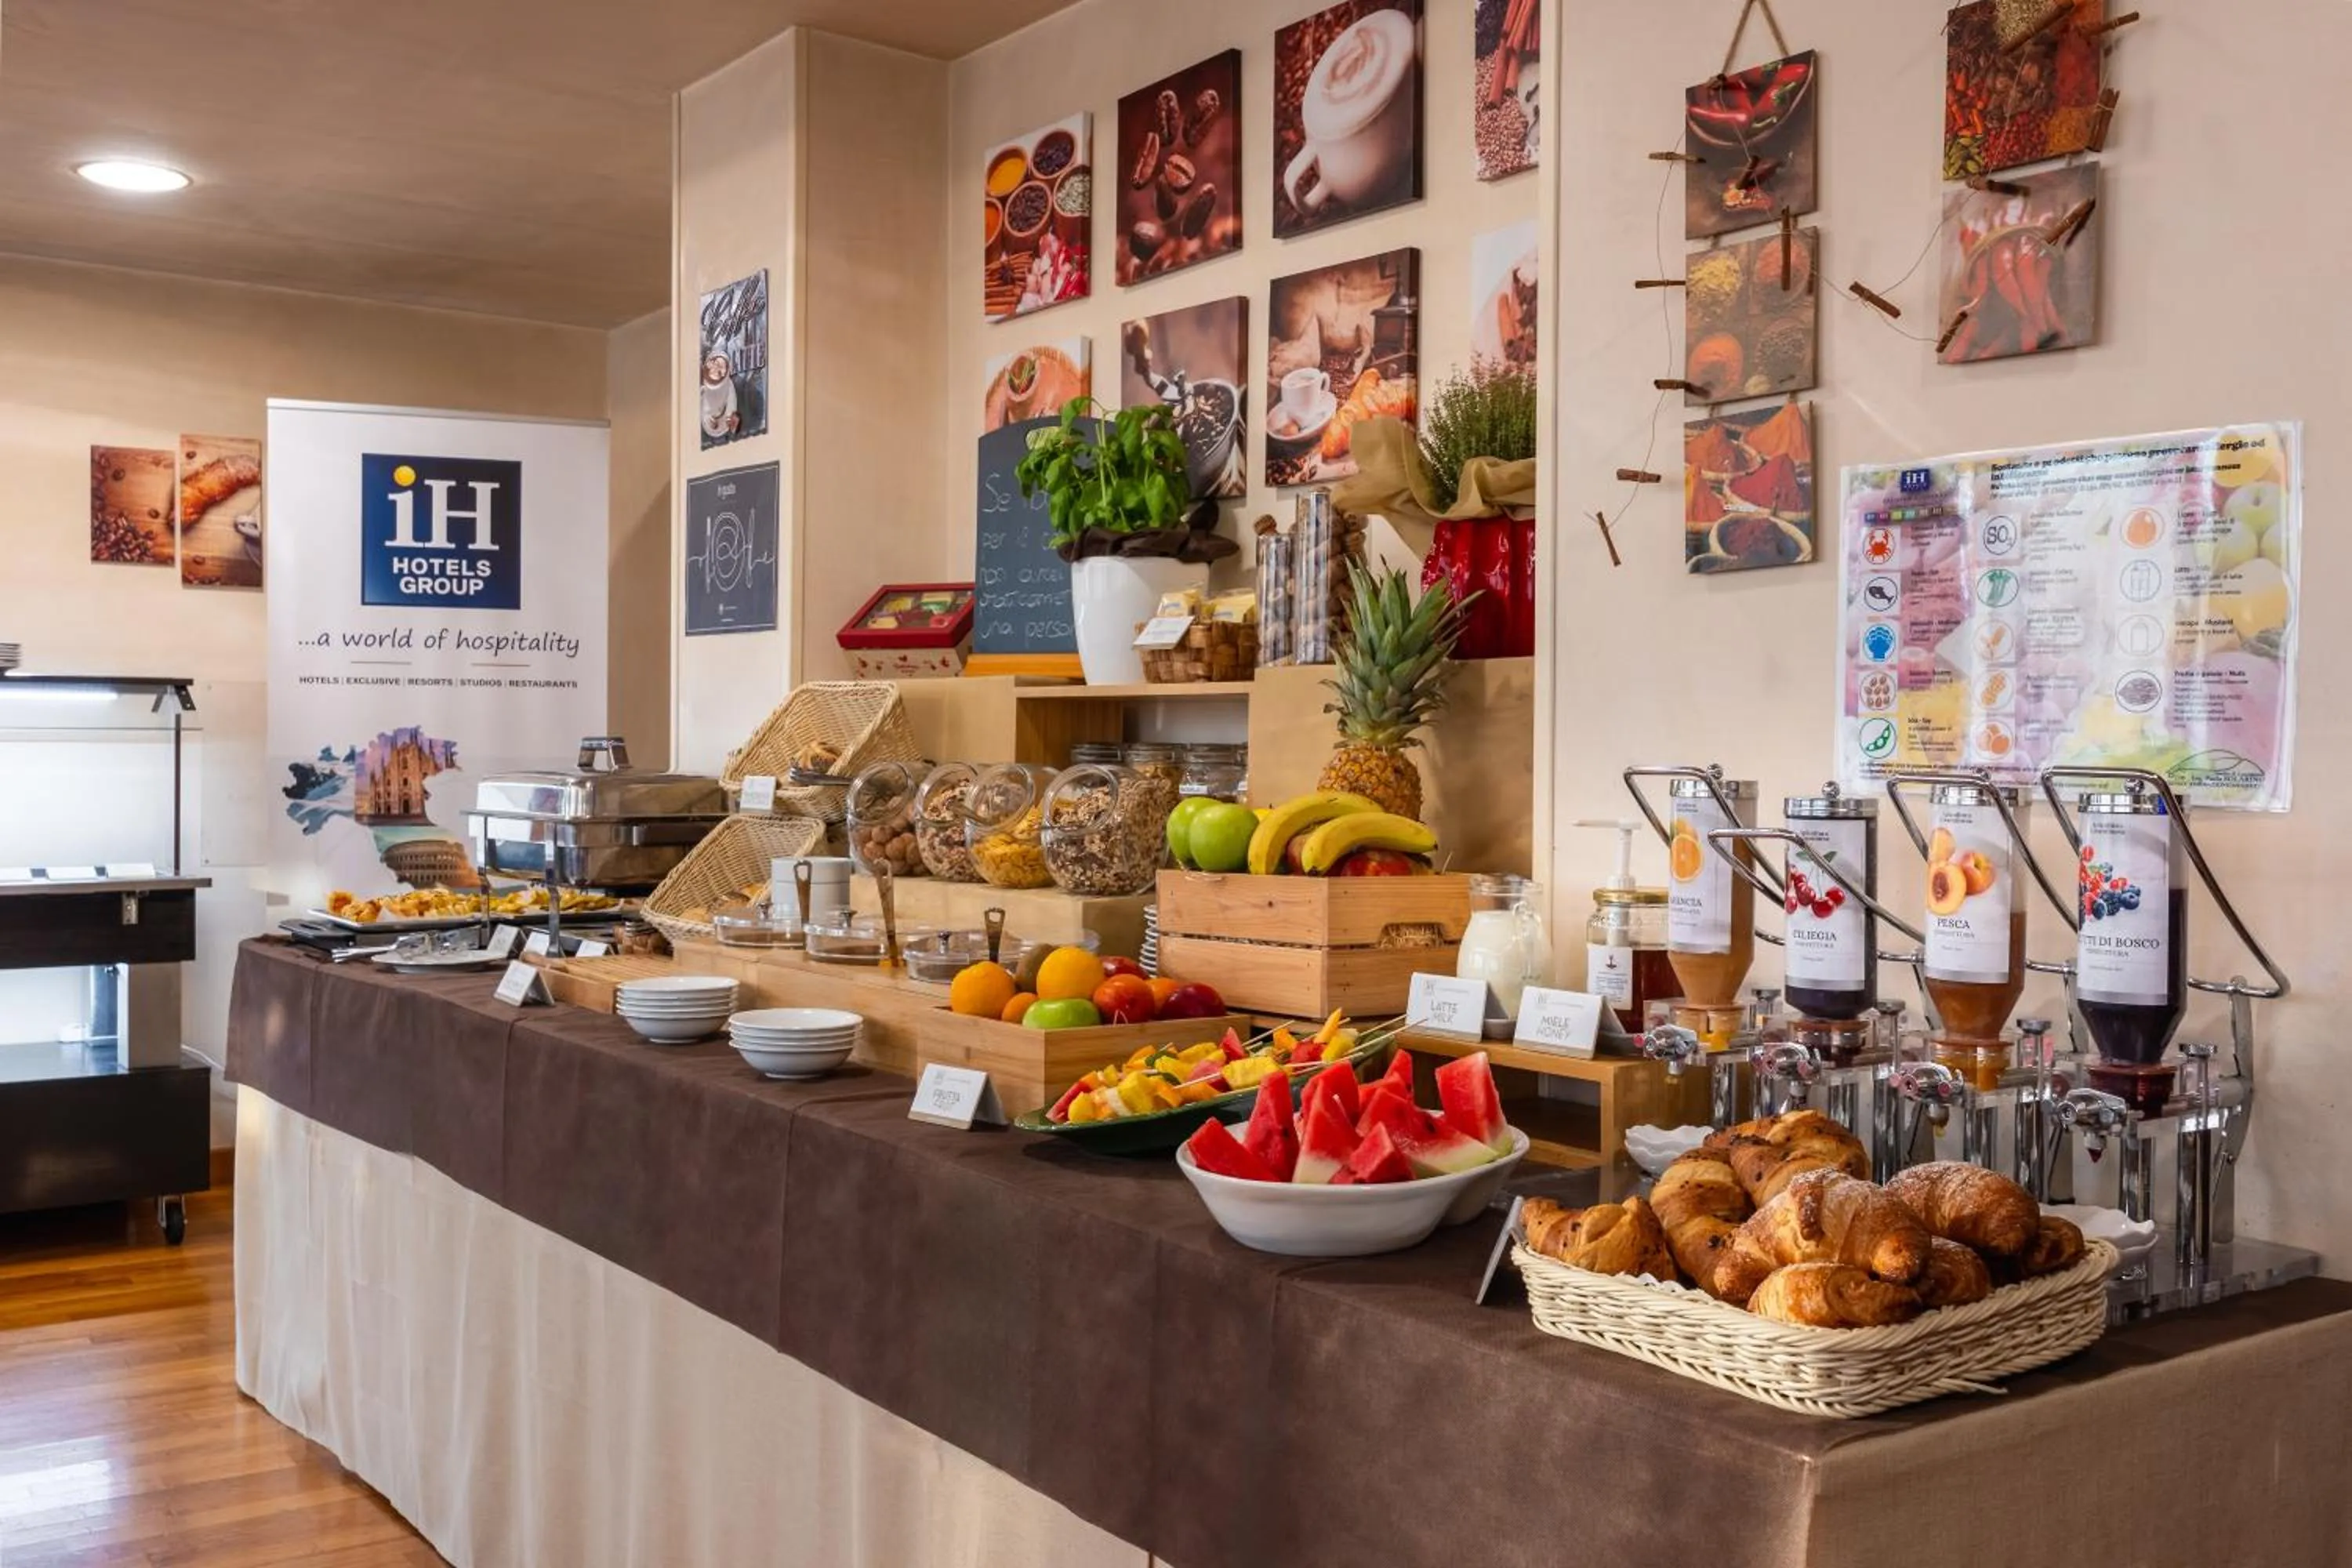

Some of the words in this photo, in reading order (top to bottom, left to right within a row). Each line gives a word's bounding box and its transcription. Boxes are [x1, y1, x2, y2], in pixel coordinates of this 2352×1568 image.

[384, 465, 500, 551] iH
[392, 557, 492, 578] HOTELS
[399, 576, 485, 596] GROUP
[342, 626, 413, 648] world
[423, 627, 449, 650] of
[456, 629, 580, 659] hospitality
[299, 677, 339, 685] HOTELS
[346, 677, 401, 686] EXCLUSIVE
[407, 677, 453, 687] RESORTS
[459, 678, 503, 688] STUDIOS
[508, 680, 579, 689] RESTAURANTS
[2098, 936, 2112, 947] DI
[2115, 937, 2161, 949] BOSCO
